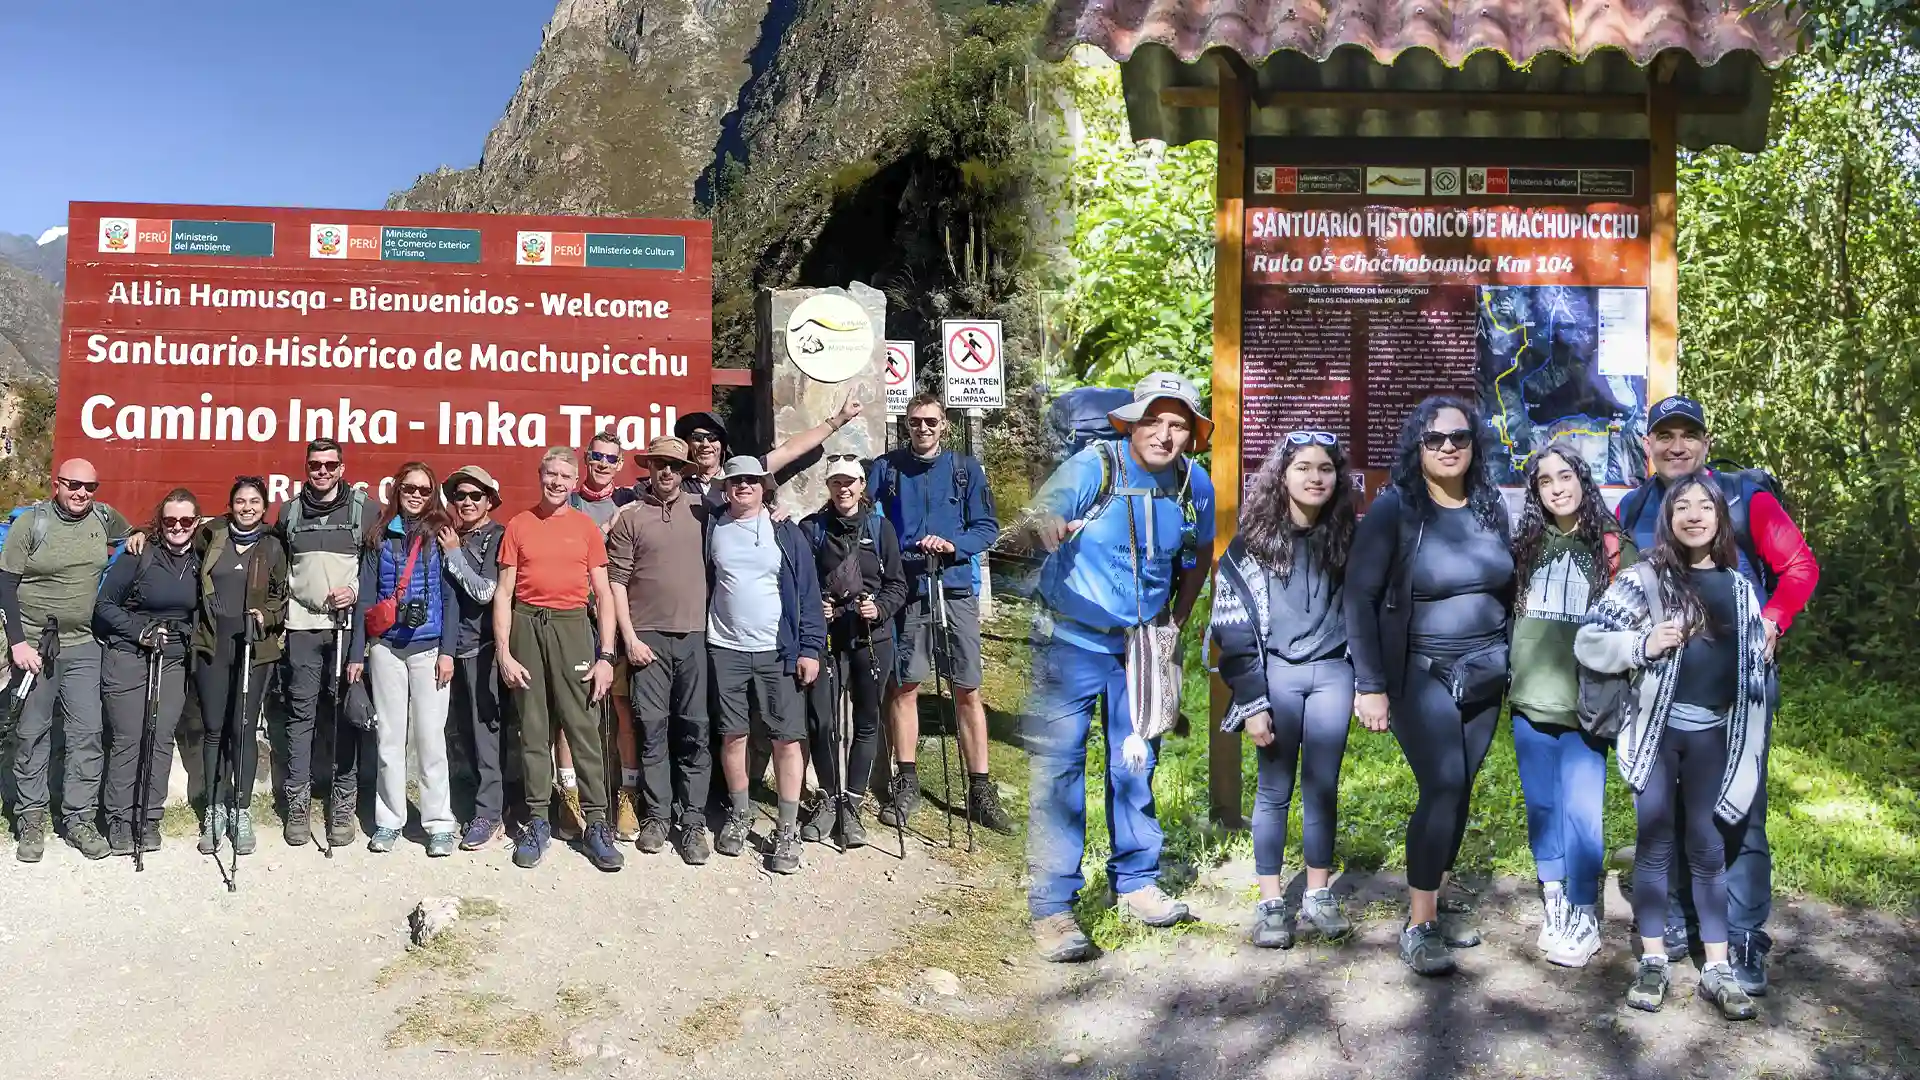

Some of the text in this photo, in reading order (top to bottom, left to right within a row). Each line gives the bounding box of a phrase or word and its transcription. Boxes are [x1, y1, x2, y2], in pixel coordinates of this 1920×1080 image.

[1252, 211, 1640, 240] SANTUARIO HISTORICO DE MACHUPICCHU
[138, 230, 167, 243] PERÚ
[175, 232, 218, 242] Ministerio
[385, 229, 428, 239] Ministerio
[174, 242, 231, 252] del Ambiente
[350, 236, 378, 249] PERÚ
[385, 239, 471, 250] de Comercio Exterior
[385, 249, 425, 258] y Turismo
[554, 243, 582, 256] PERÚ
[589, 245, 675, 257] Ministerio de Cultura
[1252, 254, 1574, 275] Ruta 05 Chachabamba Km 104
[1378, 287, 1429, 295] MACHUPICCHU
[108, 281, 180, 306] Allin
[190, 284, 325, 315] Hamusqa
[350, 286, 518, 314] Bienvenidos
[541, 293, 669, 318] Welcome
[87, 331, 687, 382] Santuario Histórico de Machupicchu
[949, 377, 999, 386] CHAKA TREN
[886, 388, 908, 396] IDGE
[963, 387, 986, 395] AMA
[949, 395, 1000, 403] CHIMPAYCHU
[81, 393, 277, 442] Camino
[289, 398, 397, 444] Inka
[439, 401, 546, 447] Inka
[560, 403, 676, 452] Trail
